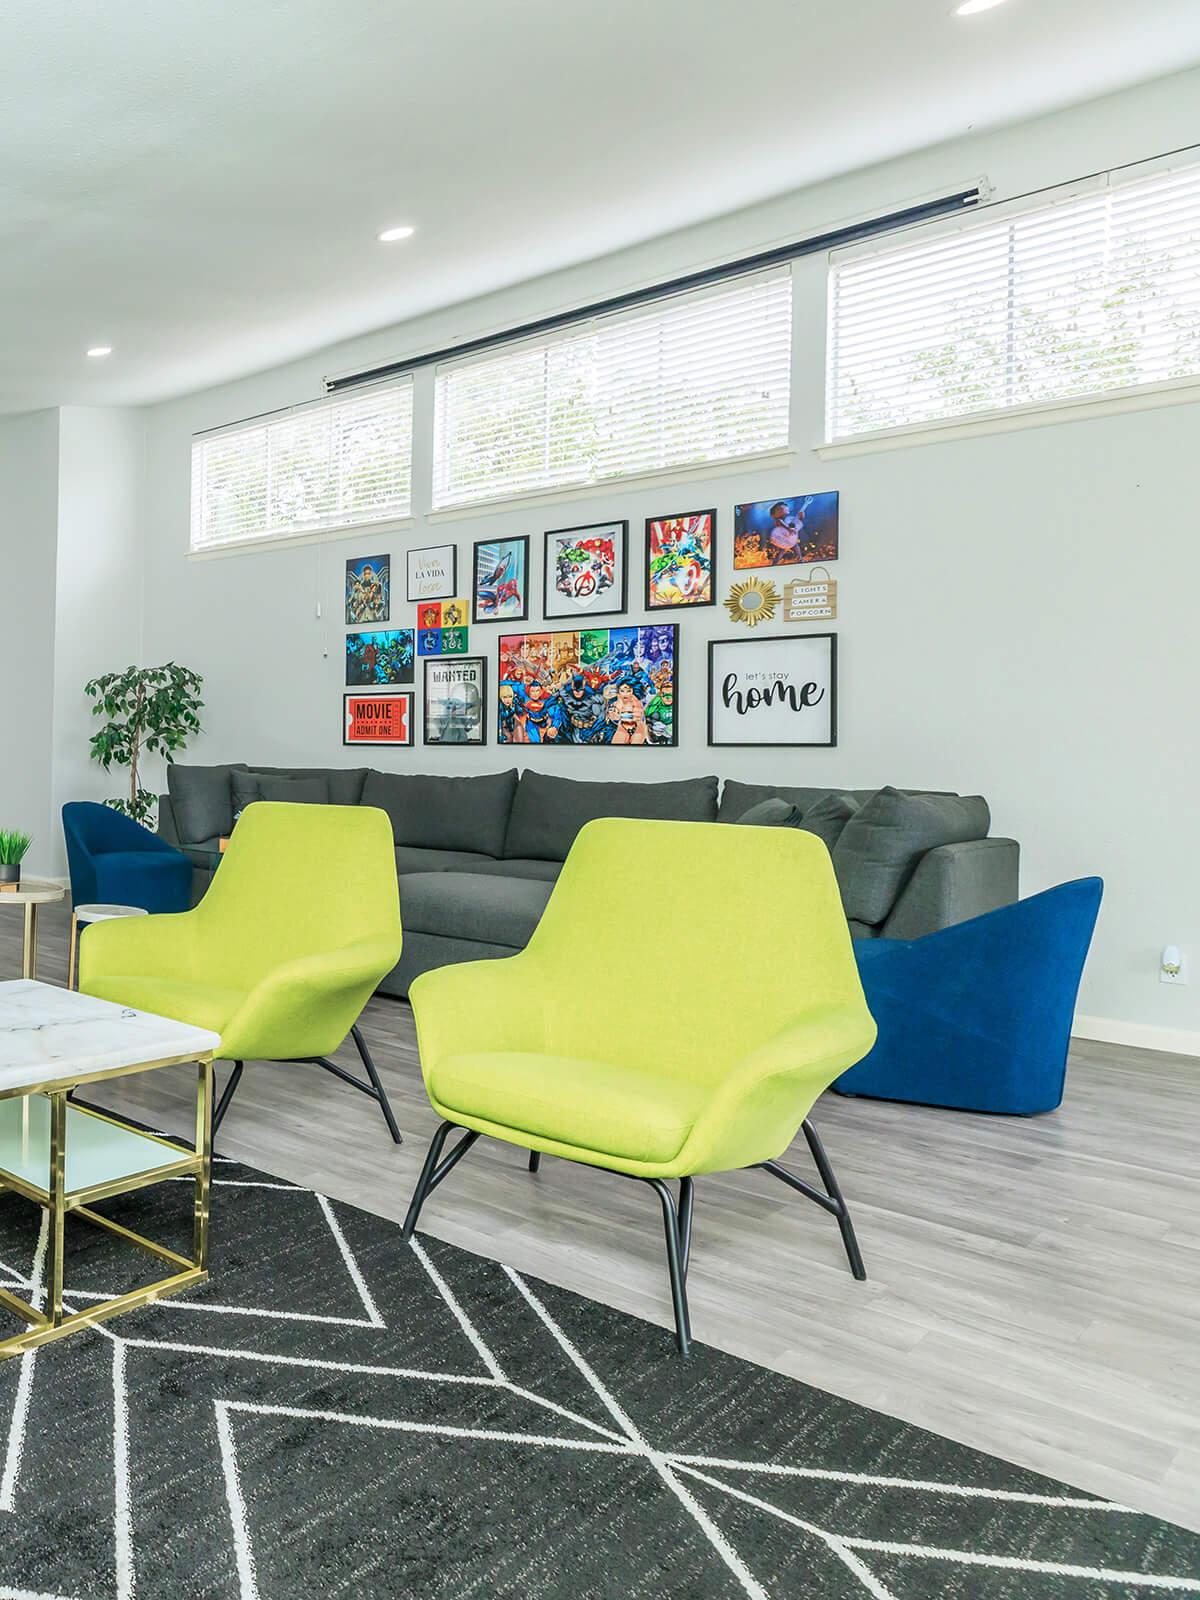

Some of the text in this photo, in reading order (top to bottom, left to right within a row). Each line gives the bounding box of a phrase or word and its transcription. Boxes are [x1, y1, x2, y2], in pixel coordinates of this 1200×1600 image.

[415, 569, 445, 579] LA VIDA
[794, 586, 827, 594] LIGHTS
[792, 597, 826, 605] CAMERA
[433, 669, 477, 682] WANTED
[745, 672, 790, 681] let's stay
[722, 672, 825, 715] home
[356, 703, 393, 719] MOVIE
[356, 725, 392, 735] ADMIT ONE
